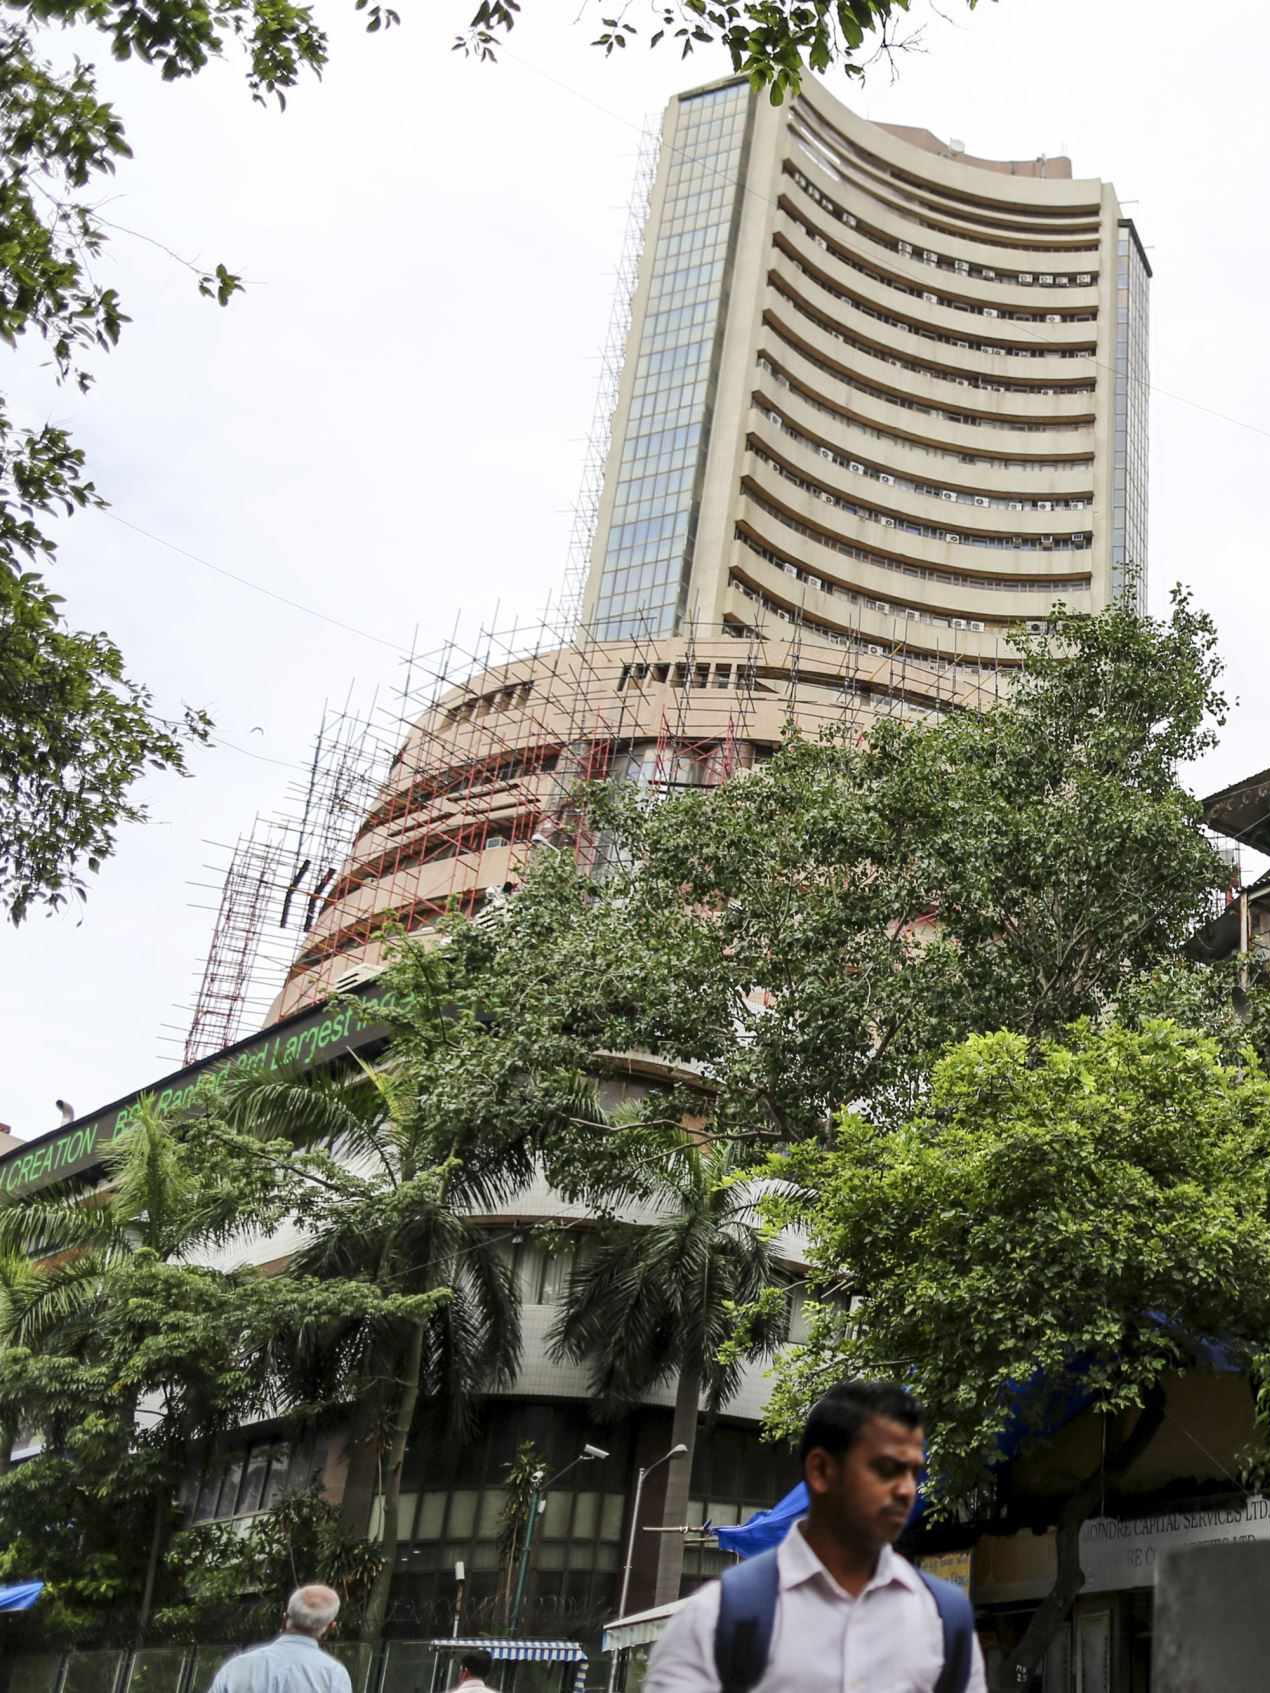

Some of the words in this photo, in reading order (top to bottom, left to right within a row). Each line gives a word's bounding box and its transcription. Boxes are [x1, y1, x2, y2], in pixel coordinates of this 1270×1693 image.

[6, 1123, 98, 1192] CREATION
[271, 1008, 354, 1071] Largest
[1083, 1517, 1131, 1543] JOINDRE
[1134, 1512, 1180, 1536] CAPITAL
[1184, 1507, 1242, 1530] SERVICES
